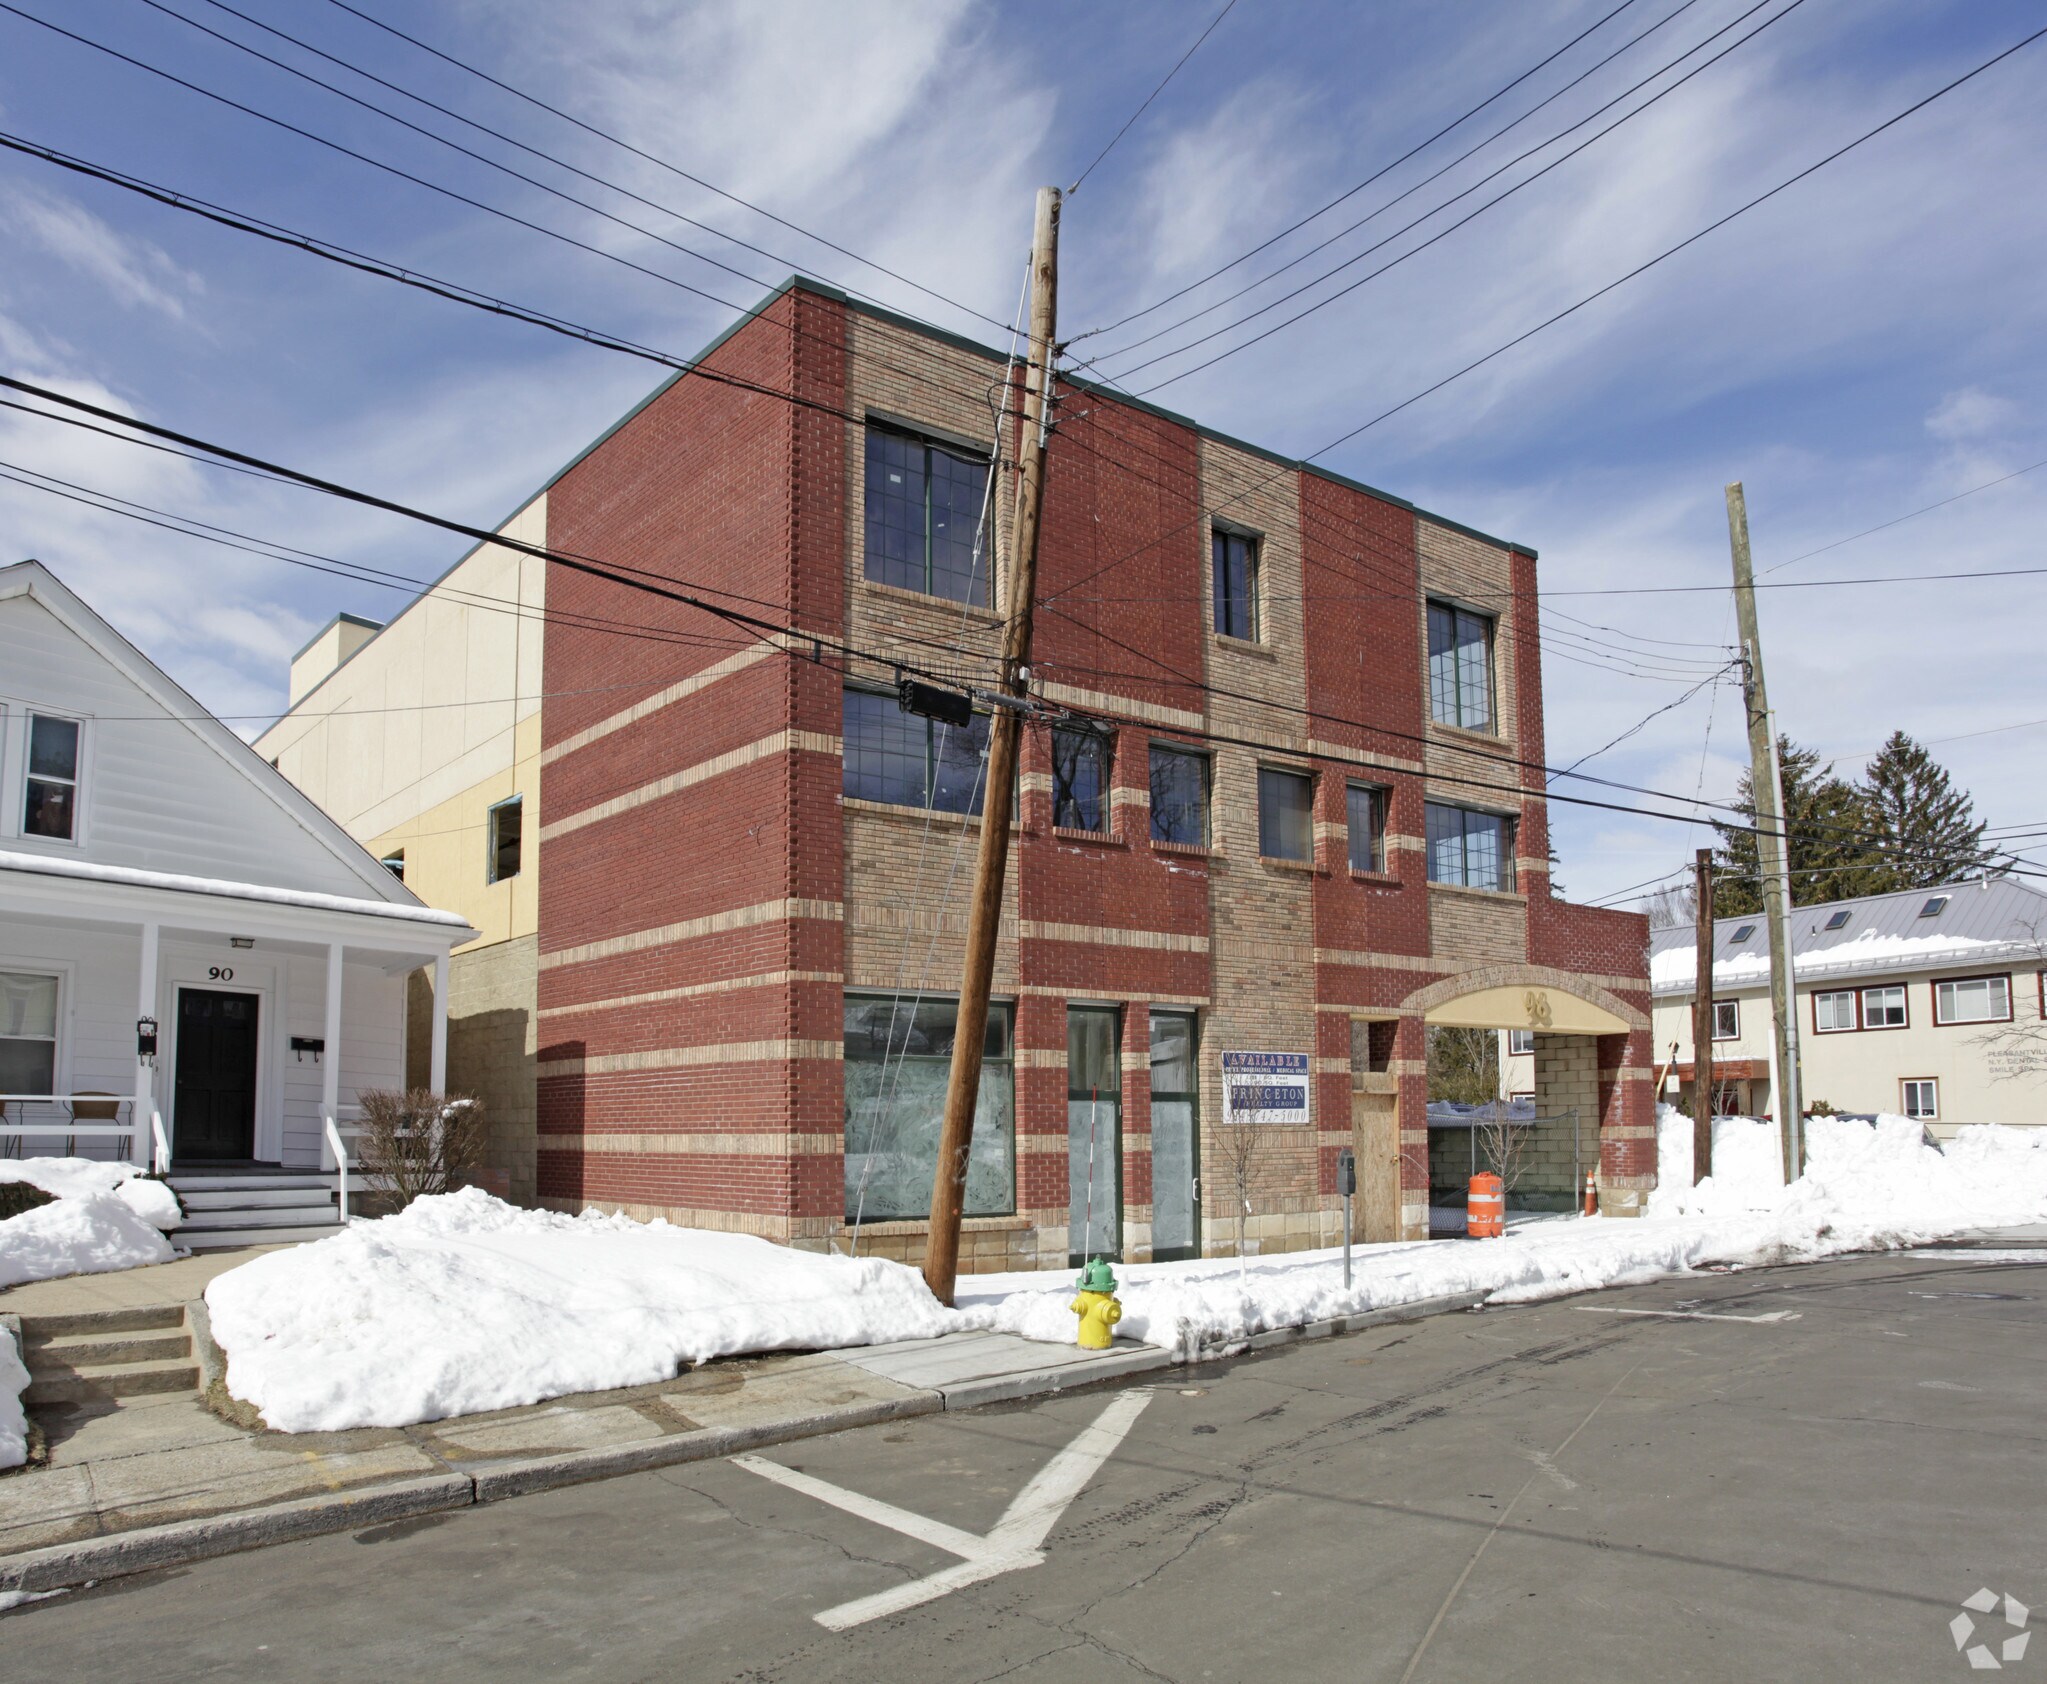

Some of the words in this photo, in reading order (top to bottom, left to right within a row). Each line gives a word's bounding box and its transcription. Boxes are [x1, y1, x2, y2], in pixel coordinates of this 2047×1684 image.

[208, 966, 234, 981] 90
[1231, 1054, 1300, 1067] AVAILABLE
[1233, 1088, 1304, 1100] PRINCETON
